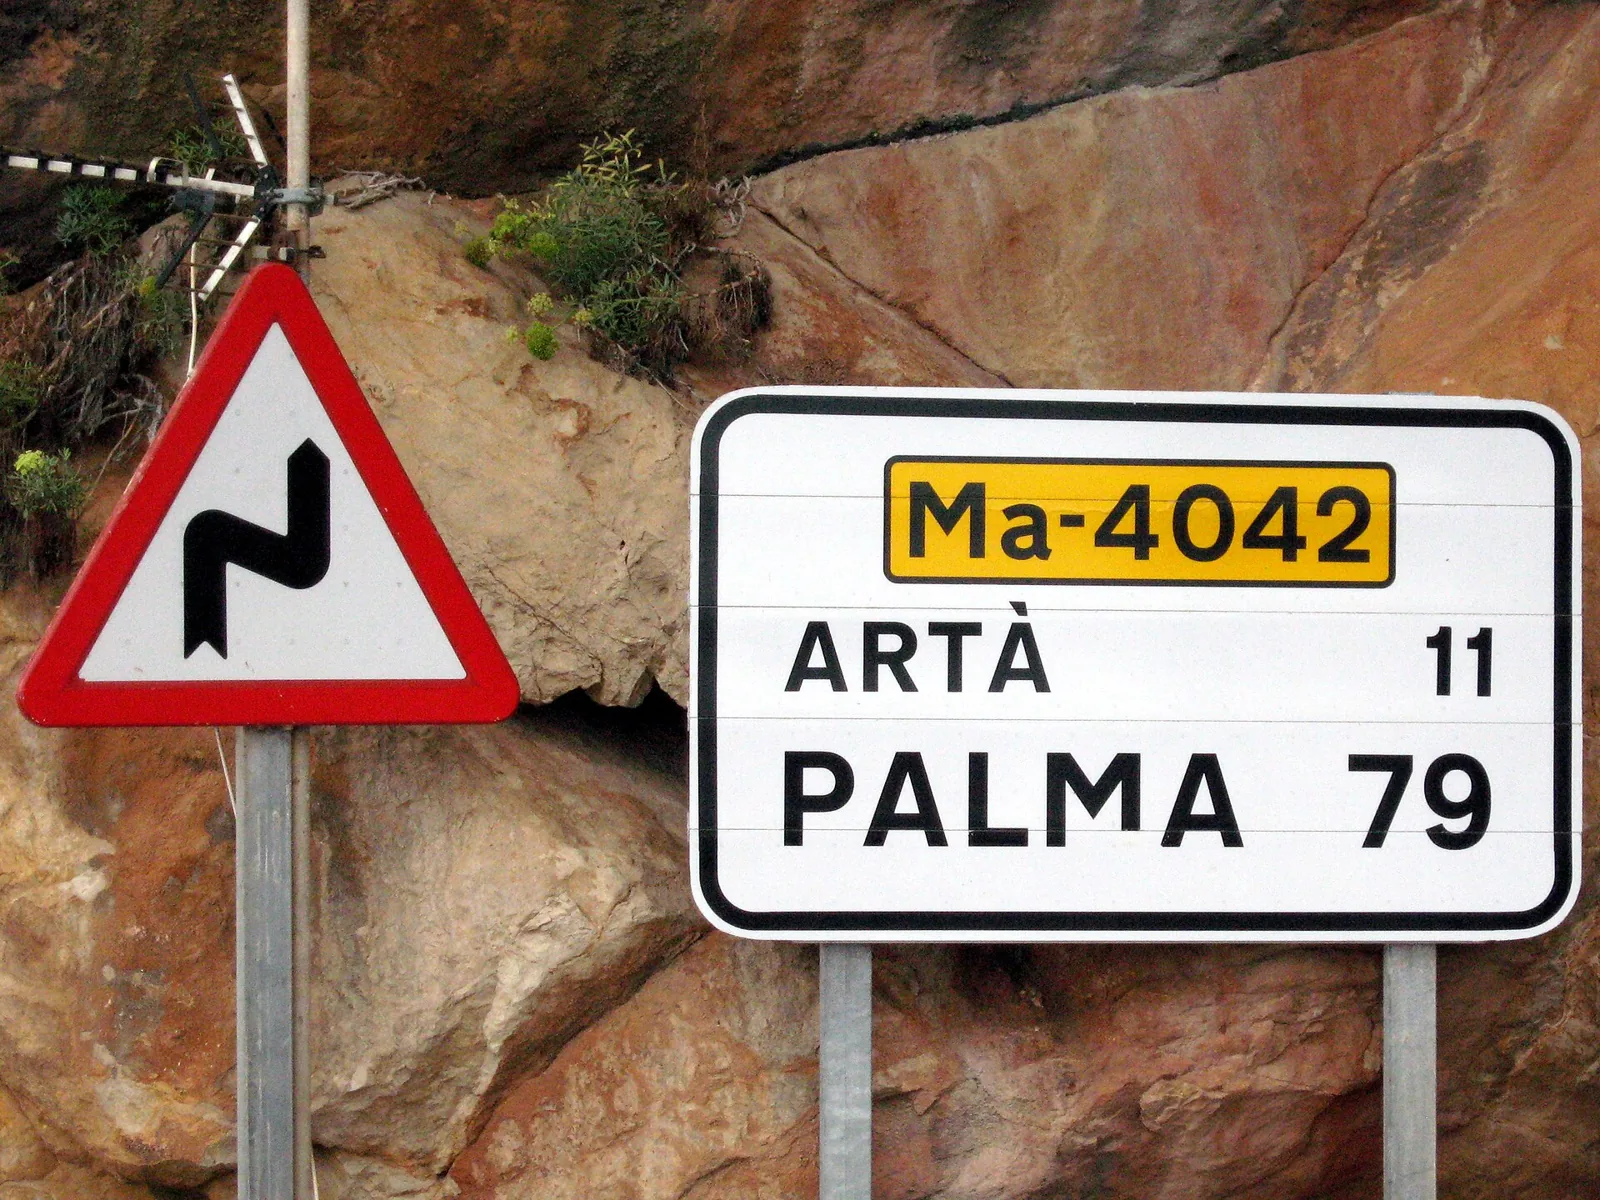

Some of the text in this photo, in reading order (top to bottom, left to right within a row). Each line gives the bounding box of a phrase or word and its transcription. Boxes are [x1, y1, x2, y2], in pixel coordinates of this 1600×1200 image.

[909, 481, 1371, 563] Ma-4042
[785, 601, 1493, 697] ARTÀ 11
[783, 750, 1492, 851] PALMA 79
